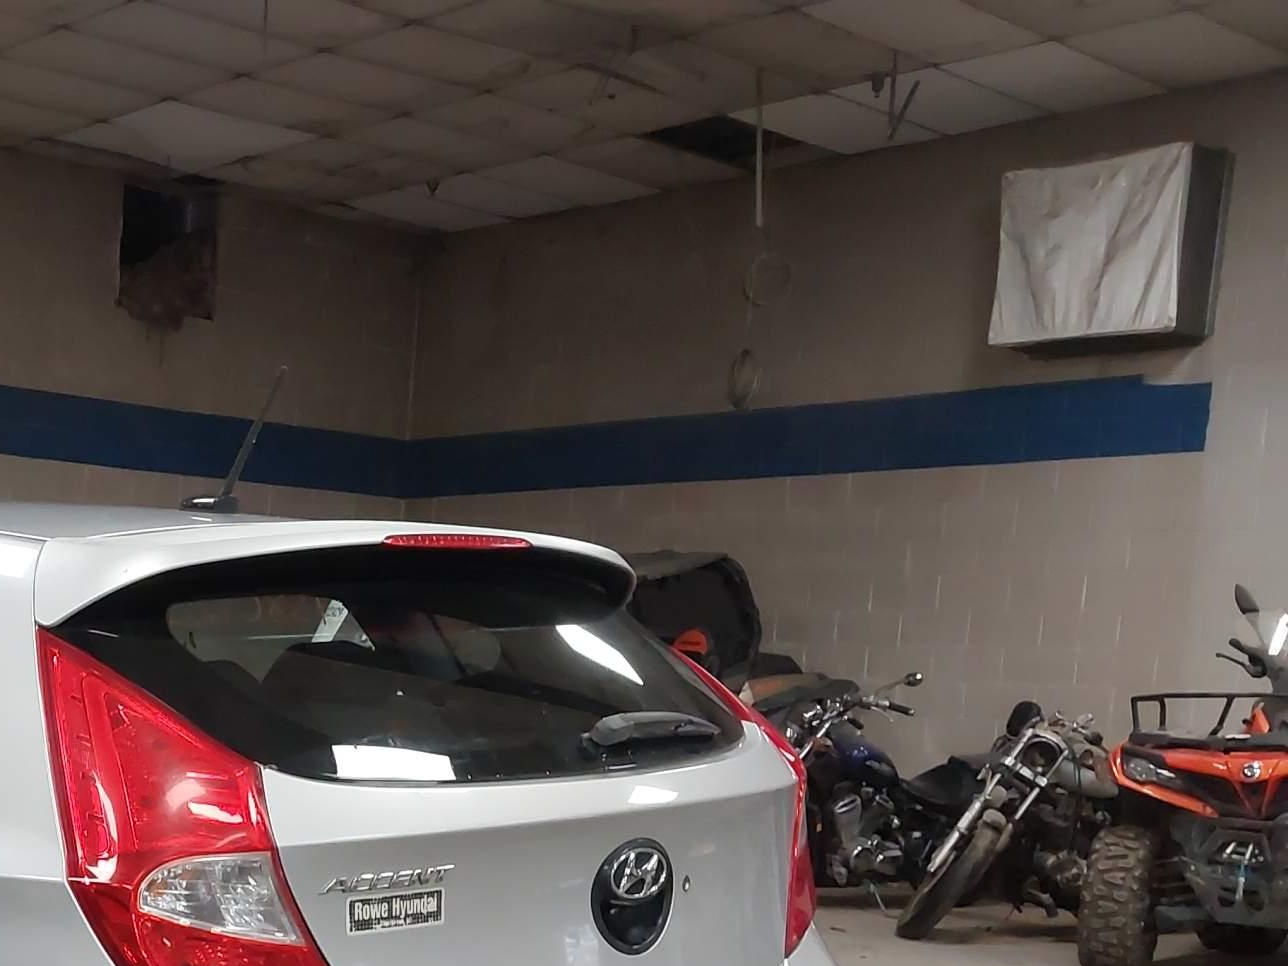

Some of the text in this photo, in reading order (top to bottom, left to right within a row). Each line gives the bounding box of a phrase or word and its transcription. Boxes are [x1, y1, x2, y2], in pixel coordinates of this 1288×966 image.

[318, 864, 456, 896] ACCENT
[354, 892, 438, 921] Rowe Hyundai
